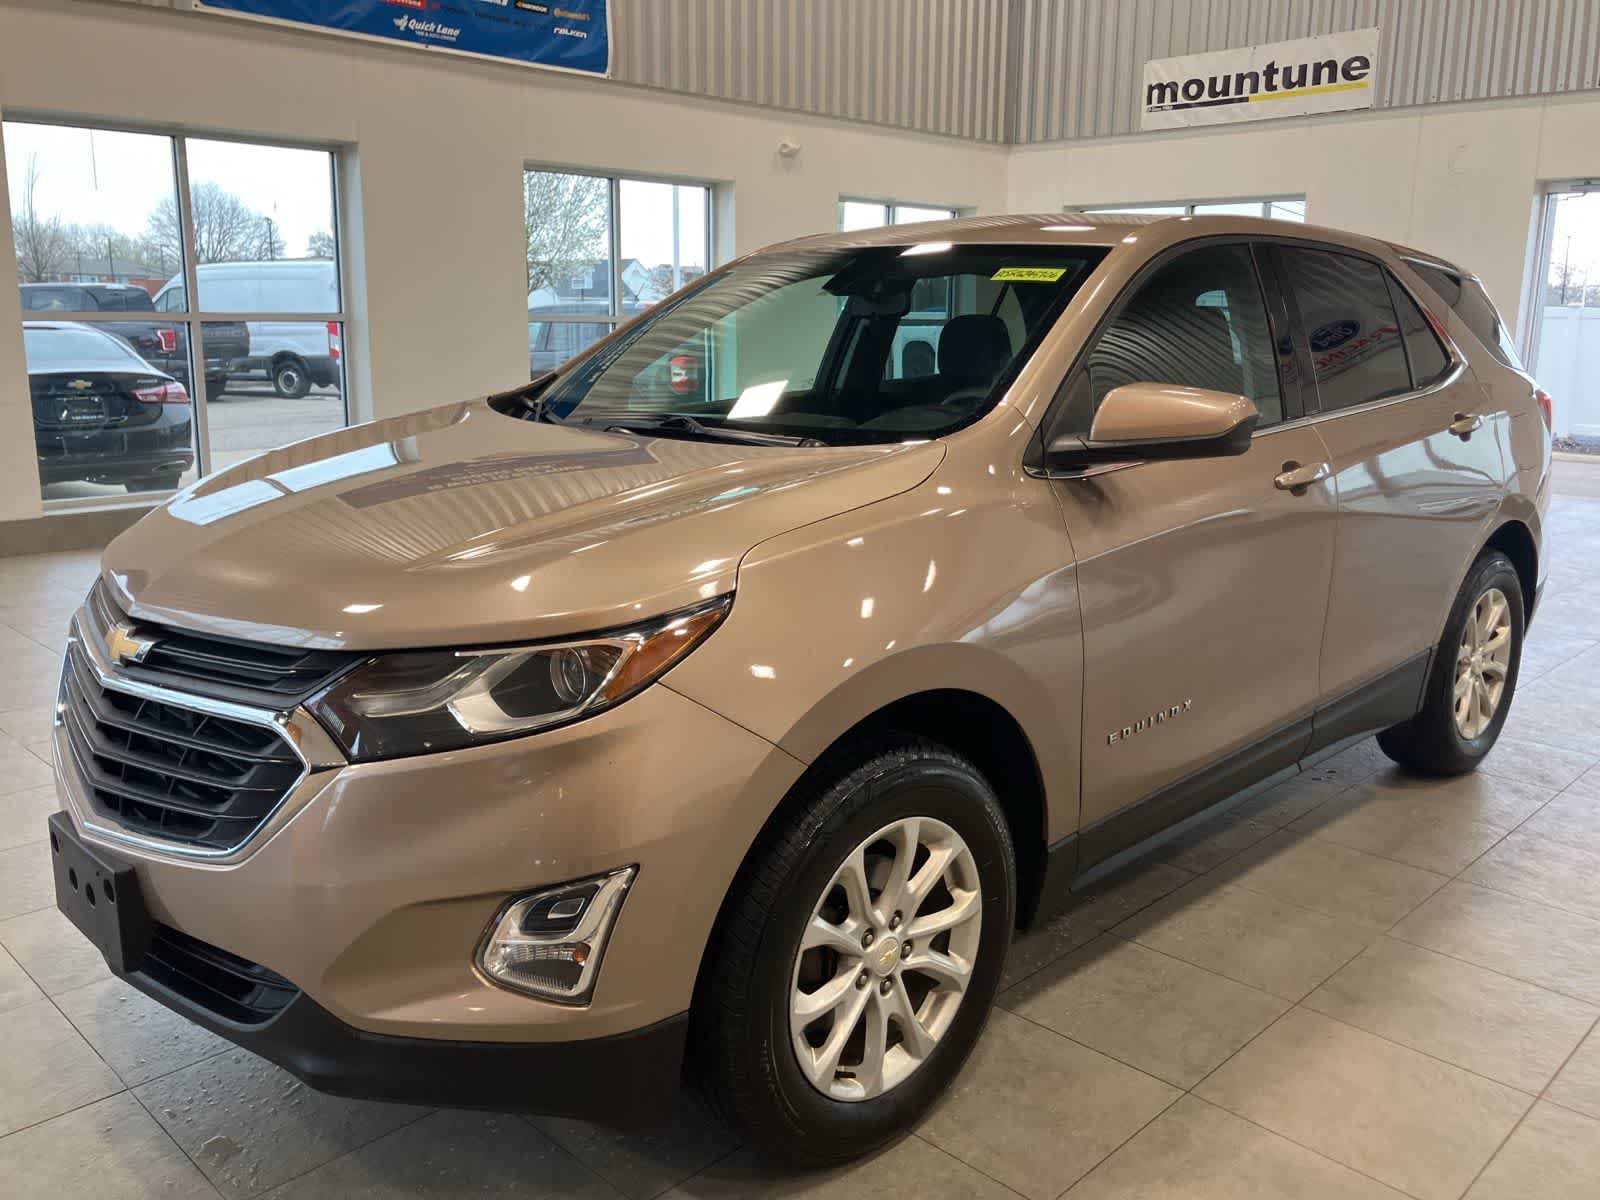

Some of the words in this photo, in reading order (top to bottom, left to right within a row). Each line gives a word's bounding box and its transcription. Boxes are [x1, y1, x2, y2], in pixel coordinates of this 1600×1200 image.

[408, 18, 436, 32] Quick
[436, 24, 461, 37] Lane
[1146, 55, 1371, 106] mountune
[1107, 699, 1193, 745] EQUINOX
